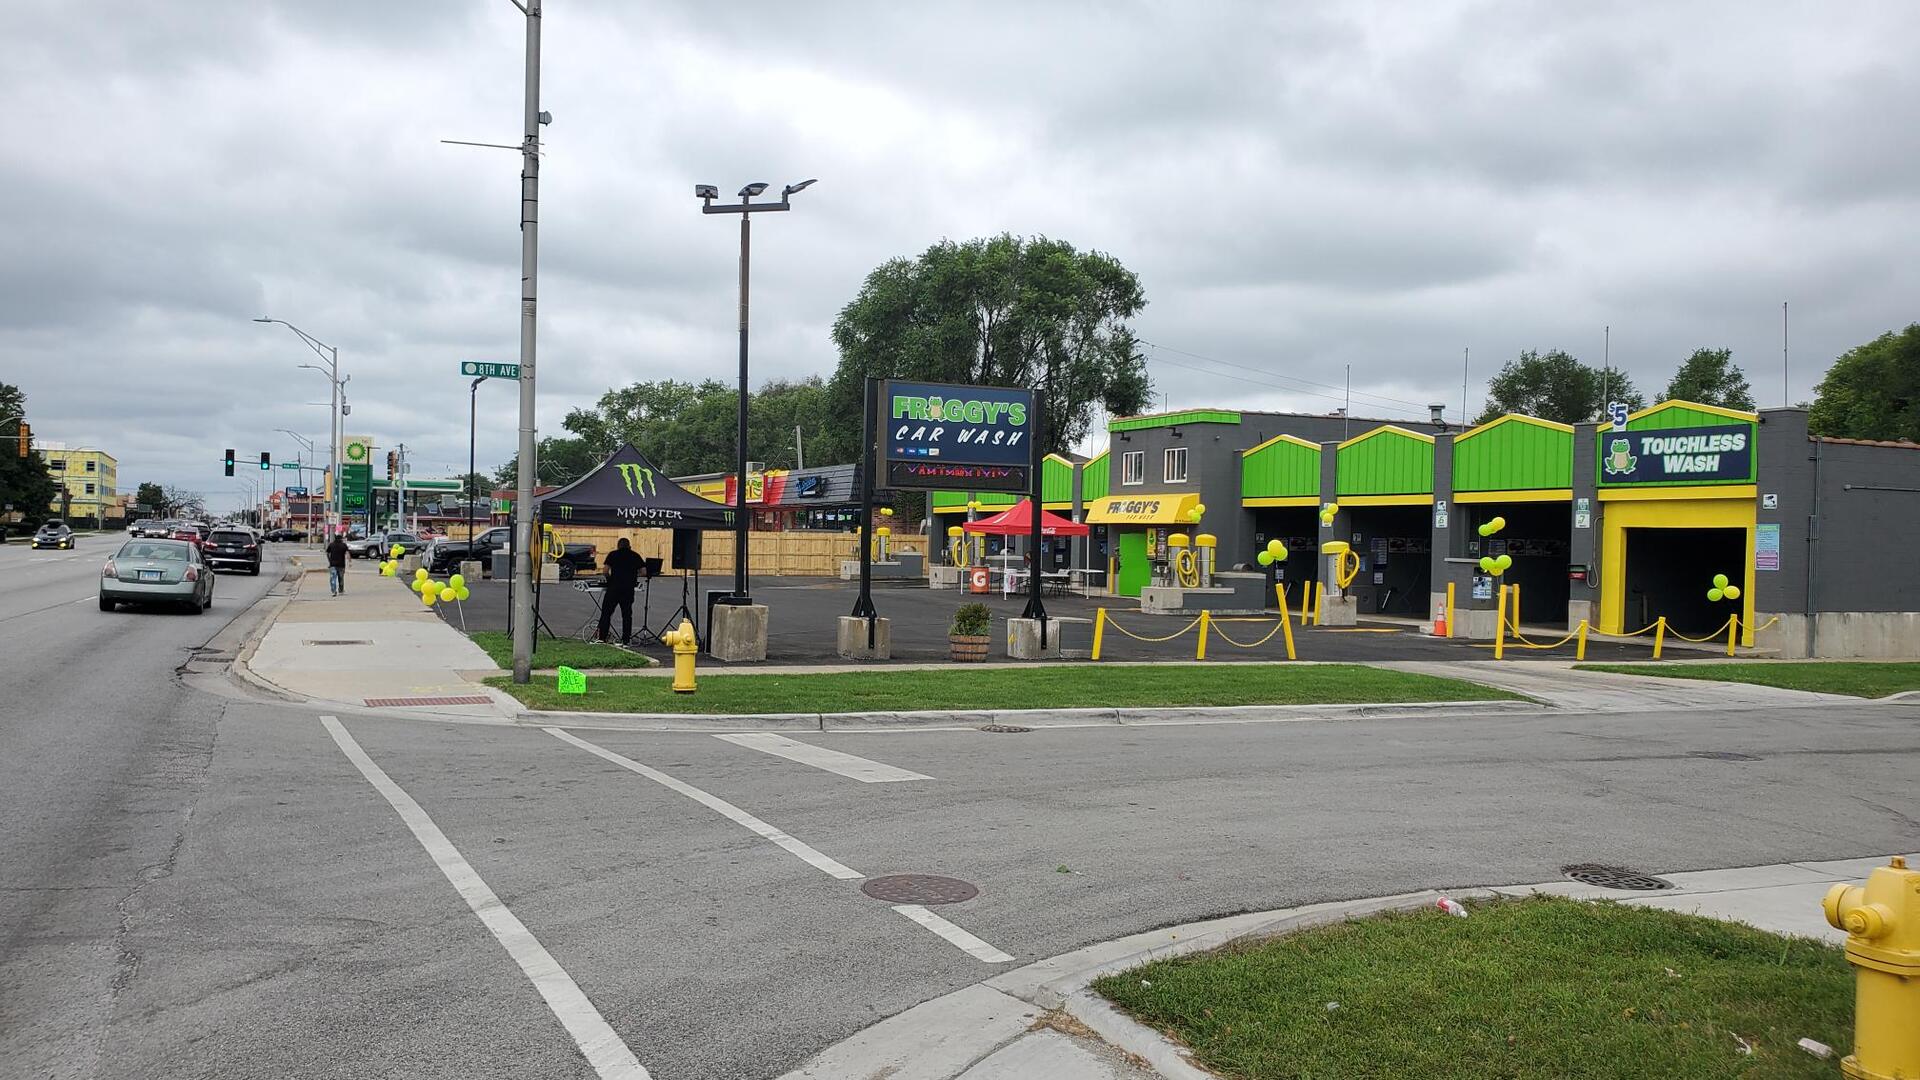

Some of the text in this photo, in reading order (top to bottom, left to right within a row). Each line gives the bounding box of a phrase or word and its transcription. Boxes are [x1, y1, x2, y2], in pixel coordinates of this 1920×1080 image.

[479, 364, 516, 377] 8TH AVE
[892, 395, 1027, 426] FRGGY'S
[1608, 403, 1628, 427] $5
[895, 425, 1024, 446] CAR WASH
[1640, 433, 1747, 456] TOUCHLESS
[1662, 454, 1721, 474] WASH
[616, 506, 684, 520] MONSTER
[1106, 500, 1161, 514] FRGGY'S
[973, 571, 987, 588] G
